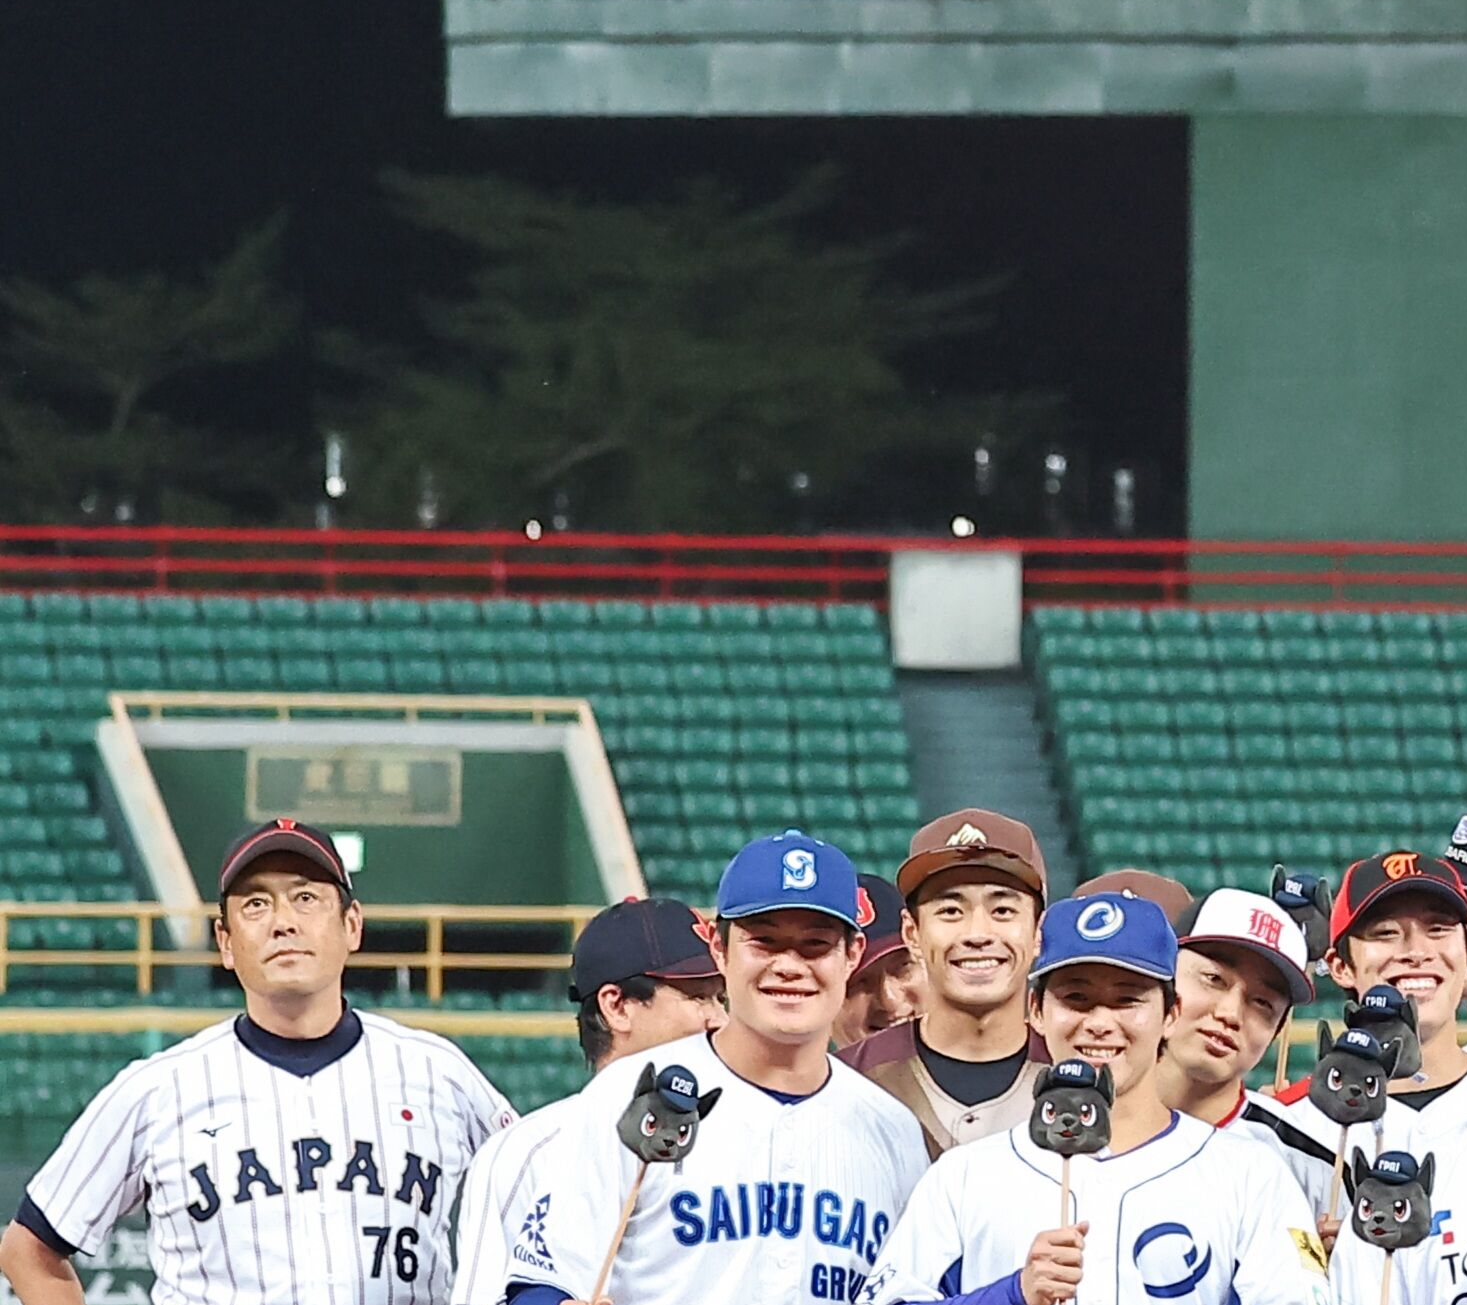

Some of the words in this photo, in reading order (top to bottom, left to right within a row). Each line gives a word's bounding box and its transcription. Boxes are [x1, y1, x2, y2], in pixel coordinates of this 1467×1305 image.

[187, 1136, 442, 1223] JAPAN
[361, 1226, 420, 1283] 76
[670, 1182, 805, 1247] SAIBU
[812, 1189, 891, 1267] GAS
